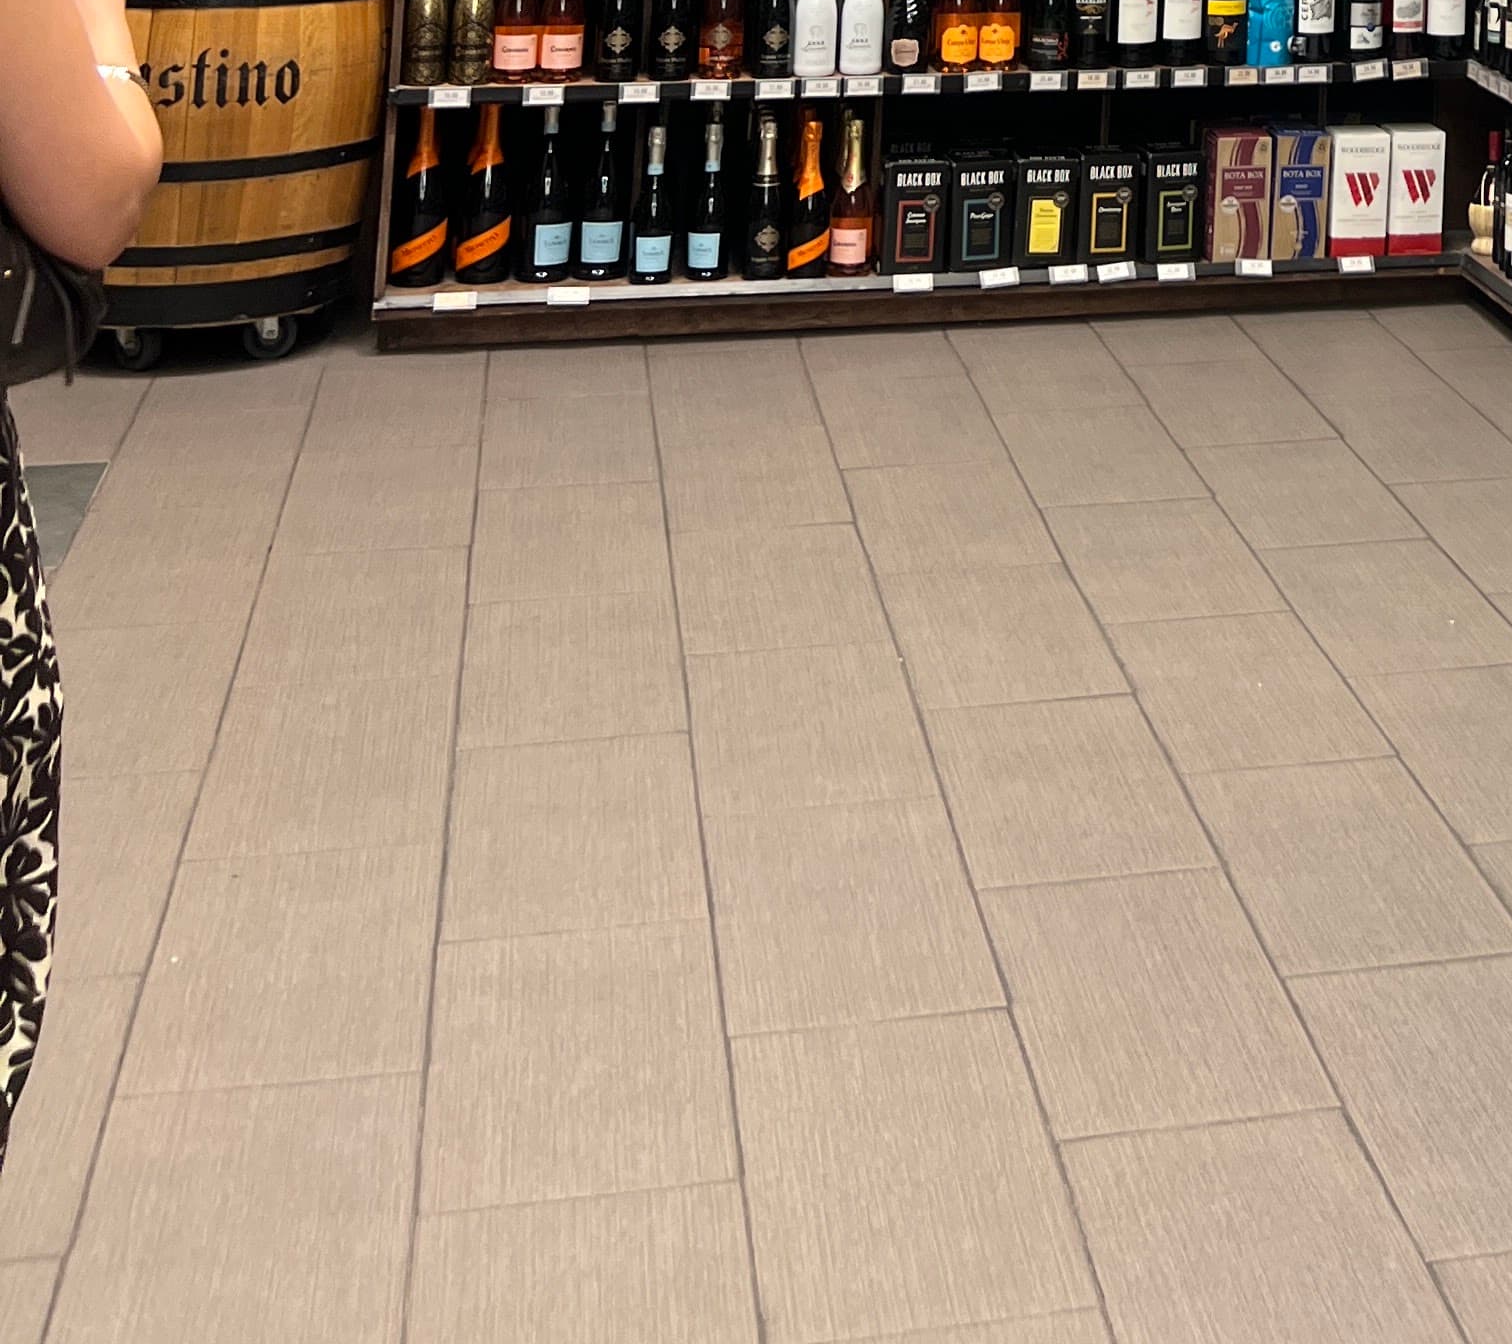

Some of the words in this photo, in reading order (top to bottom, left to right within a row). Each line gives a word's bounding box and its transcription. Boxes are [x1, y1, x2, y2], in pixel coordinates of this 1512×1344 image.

[141, 47, 301, 109] stino
[961, 170, 984, 186] BLACK
[986, 170, 1005, 186] BOX
[1027, 168, 1049, 184] BLACK
[1051, 168, 1071, 184] BOX
[1090, 165, 1112, 181] BLACK
[1114, 165, 1133, 180] BOX
[1157, 163, 1179, 179] BLACK
[1180, 162, 1199, 177] BOX
[1223, 169, 1245, 181] BOTA
[1247, 169, 1265, 181] BOX
[1282, 169, 1303, 180] BOTA
[1304, 169, 1322, 180] BOX
[897, 172, 920, 187] BLACK
[923, 172, 942, 187] BOX
